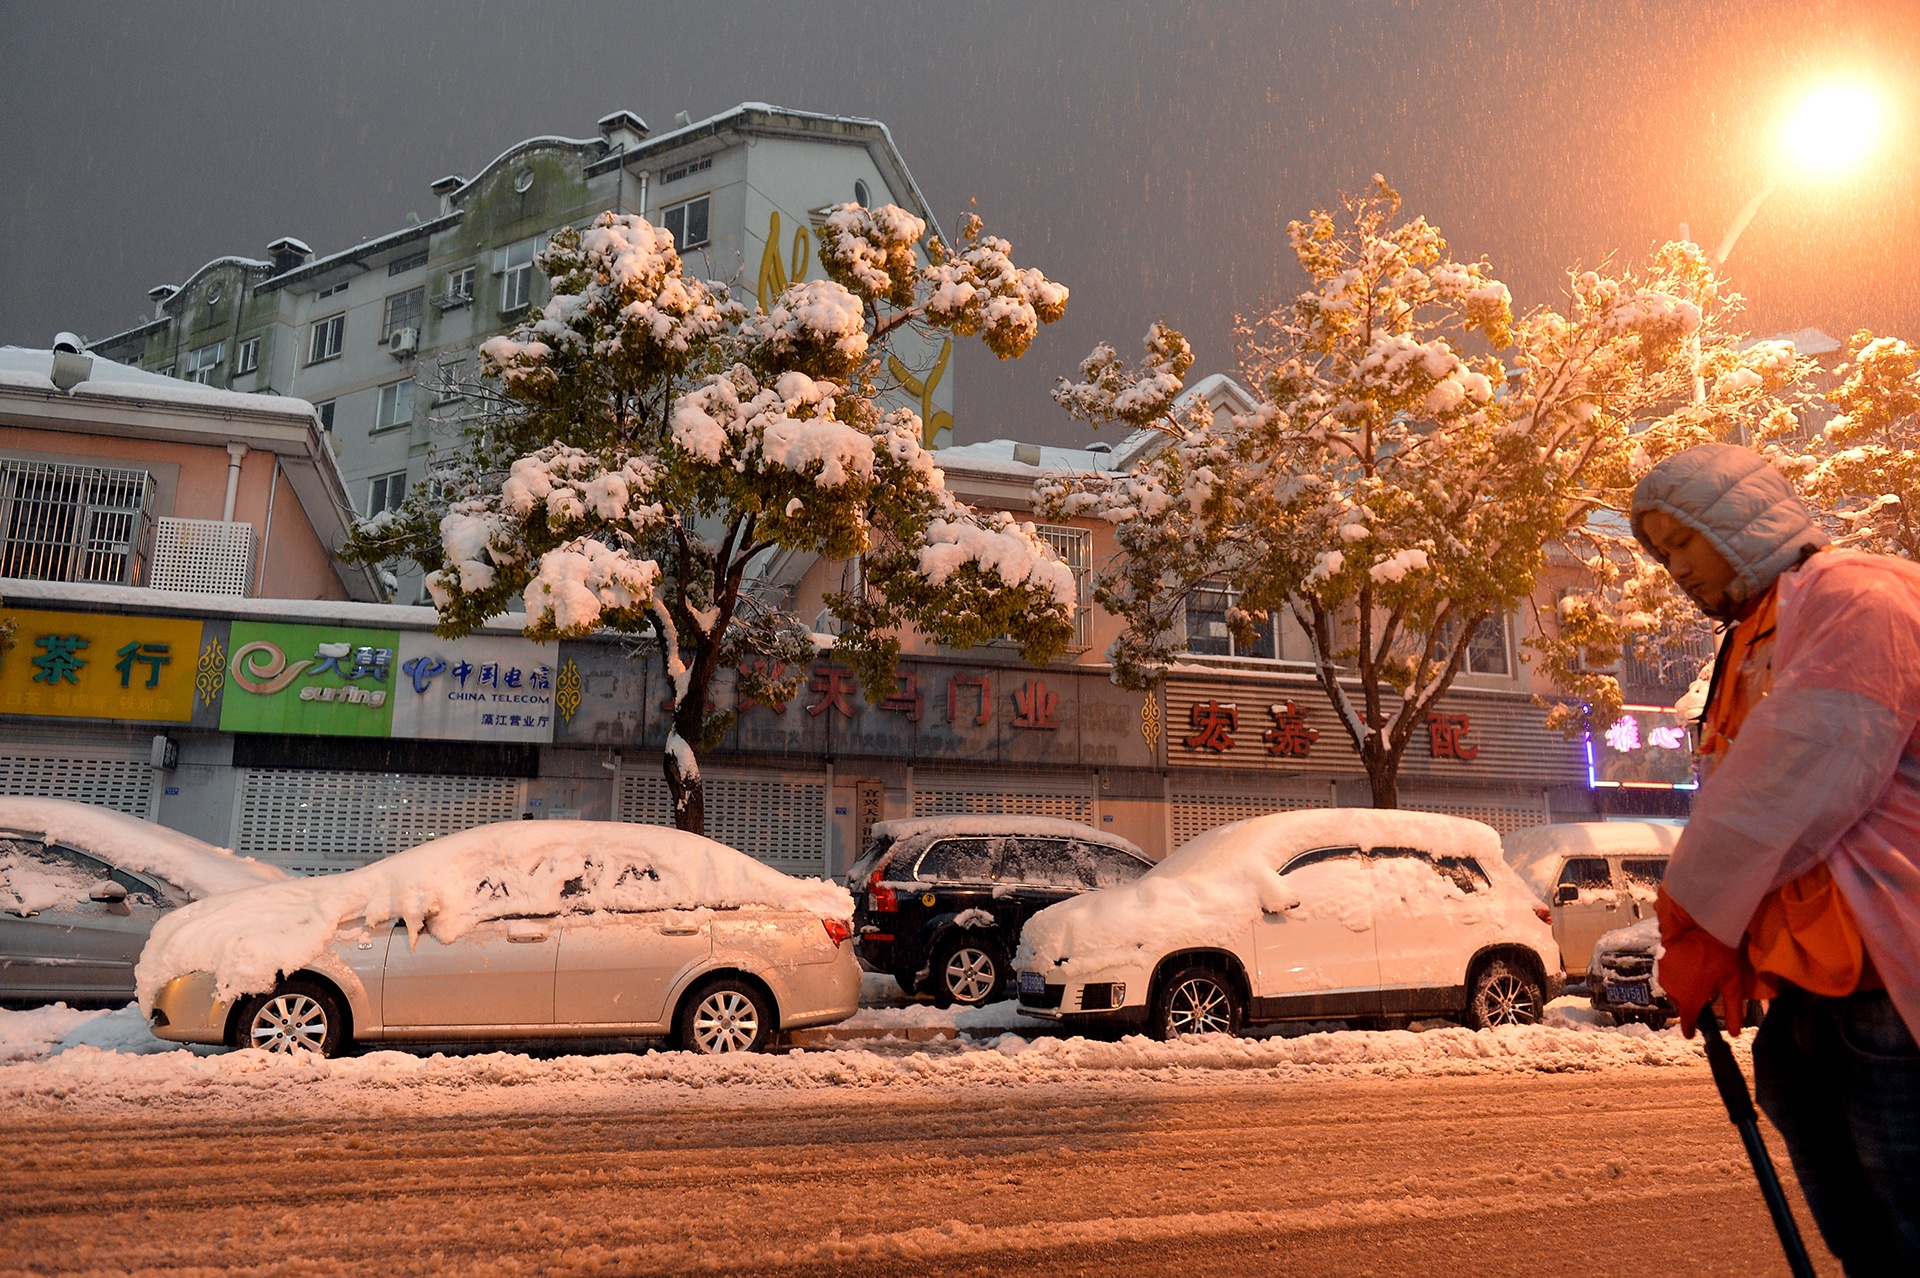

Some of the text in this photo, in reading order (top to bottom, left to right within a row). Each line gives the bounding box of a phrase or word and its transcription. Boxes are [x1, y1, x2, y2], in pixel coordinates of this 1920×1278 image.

[307, 642, 394, 682] 天翼
[451, 659, 551, 690] 中国电信
[300, 685, 387, 708] surfing
[448, 691, 550, 704] CHINA TELECOM
[661, 660, 1061, 729] 兴天马门业
[1184, 699, 1479, 760] 宏嘉配
